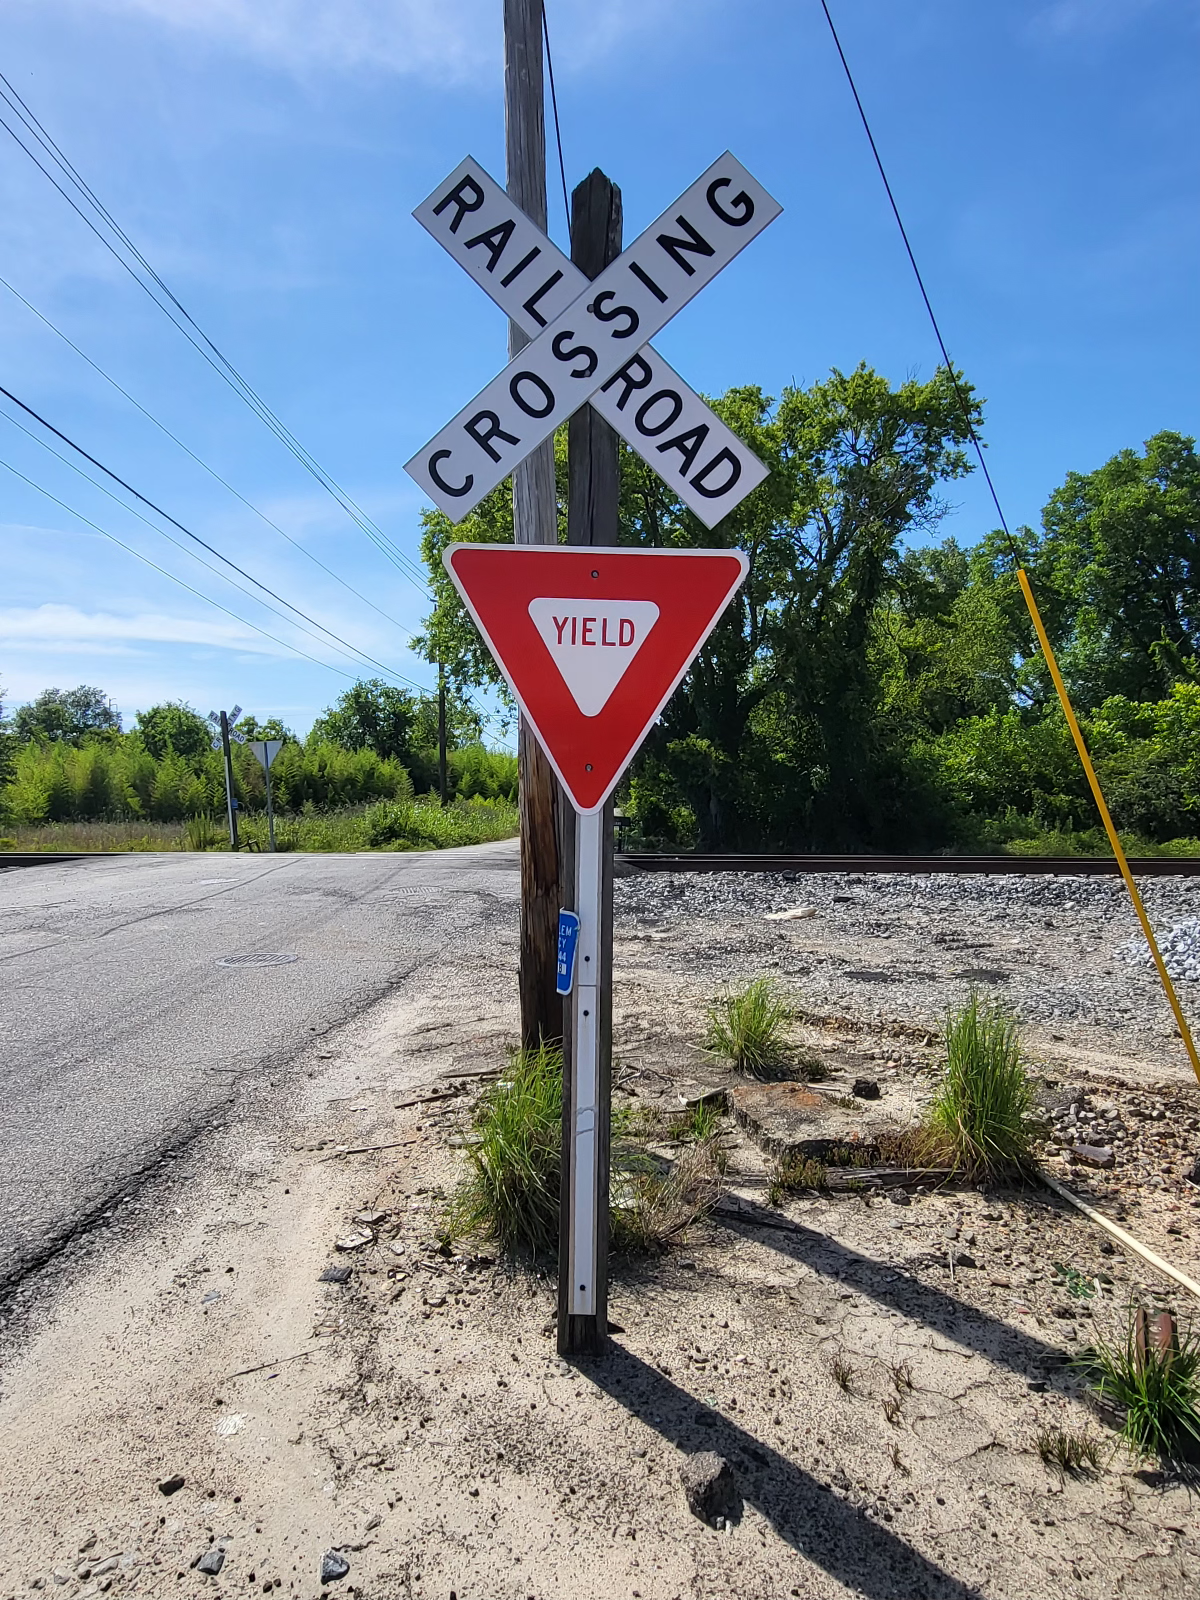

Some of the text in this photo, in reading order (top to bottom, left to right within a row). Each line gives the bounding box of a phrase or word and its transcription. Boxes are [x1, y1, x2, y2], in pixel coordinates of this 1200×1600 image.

[428, 177, 755, 497] CROSSING
[432, 173, 742, 499] RAIL ROAD
[552, 616, 636, 647] YIELD
